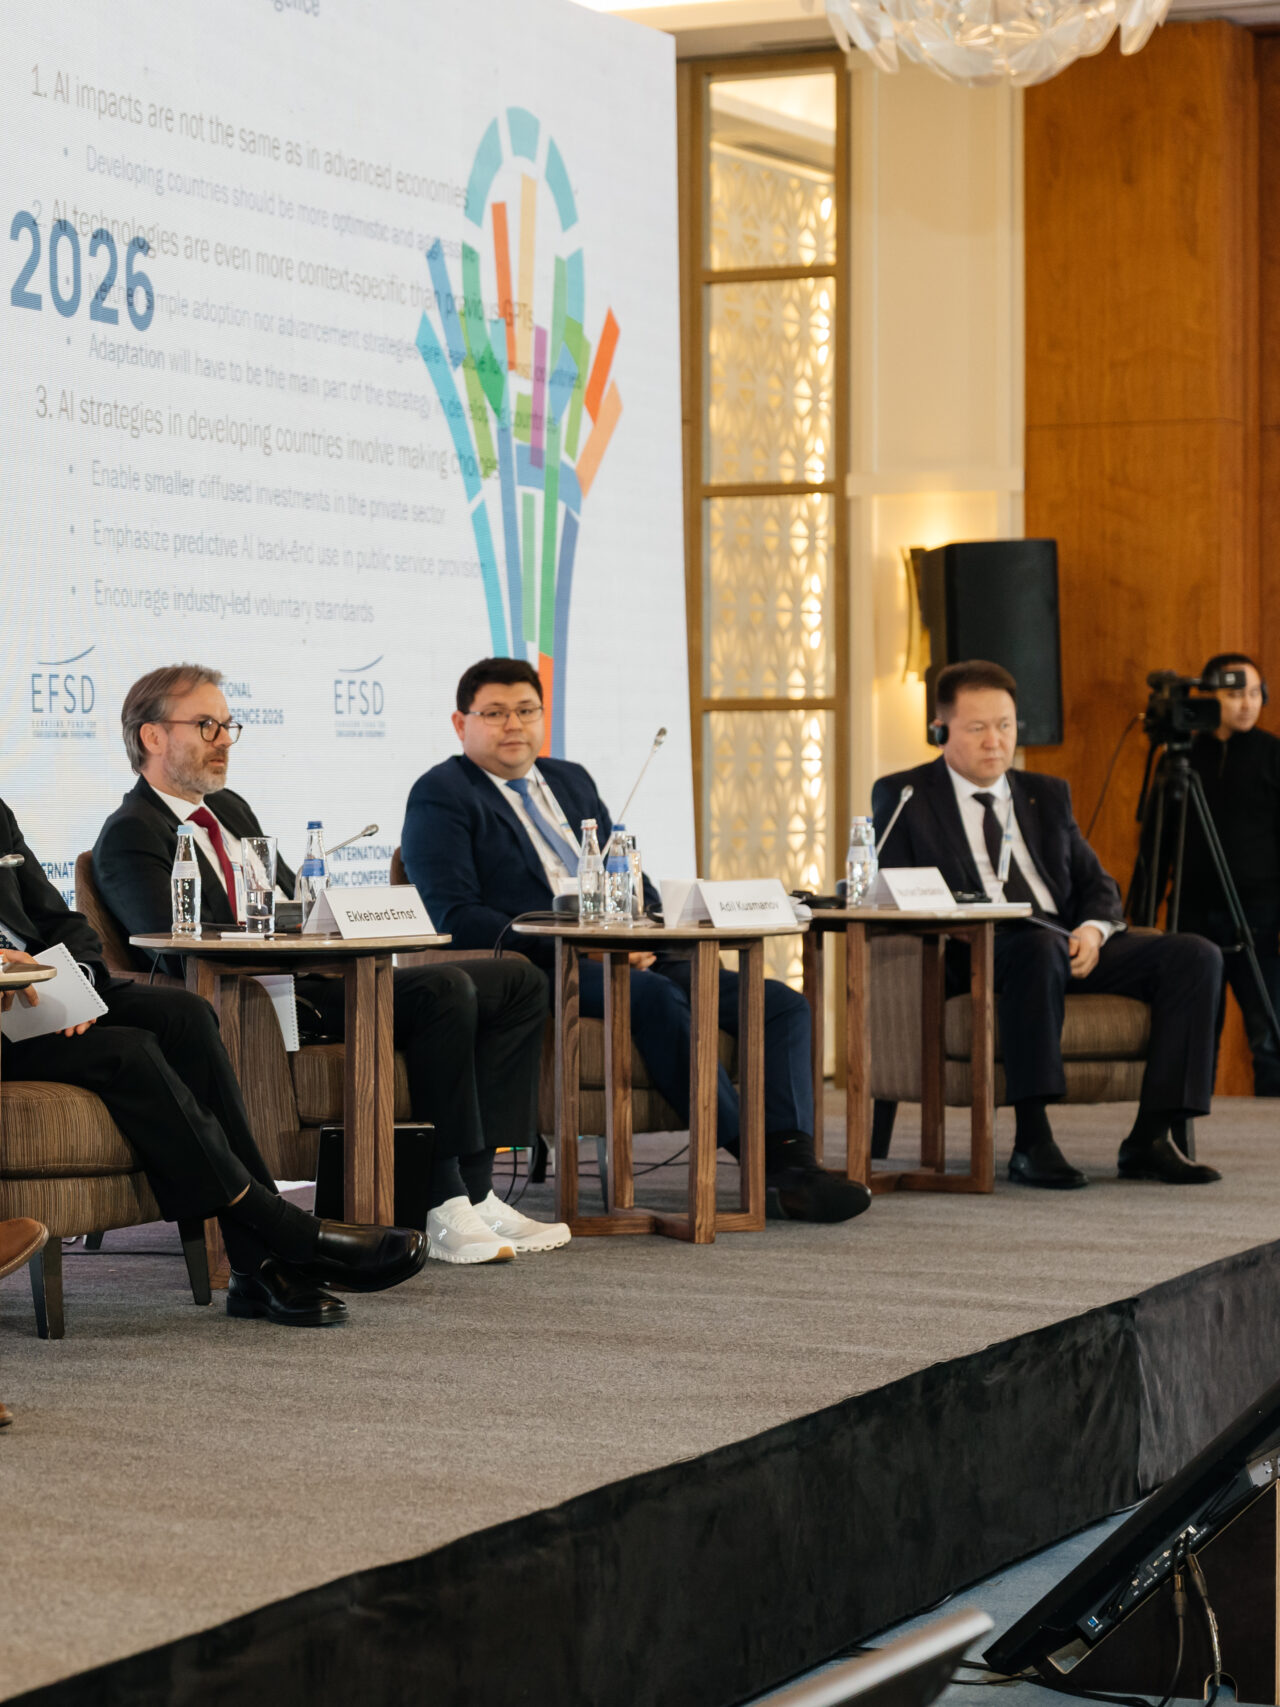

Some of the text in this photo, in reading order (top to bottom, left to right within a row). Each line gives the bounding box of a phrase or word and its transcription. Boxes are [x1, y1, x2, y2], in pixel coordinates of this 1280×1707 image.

[32, 64, 469, 209] 1. AI impacts are not the same as in advanced economies
[86, 144, 164, 196] Developing
[168, 172, 230, 206] countries
[233, 183, 277, 217] should
[279, 192, 294, 220] be
[297, 202, 329, 229] more
[9, 210, 155, 331] 2026
[184, 234, 210, 264] are
[215, 241, 251, 273] even
[256, 252, 294, 282] more
[89, 333, 165, 369] Adaptation
[170, 348, 190, 374] will
[195, 351, 226, 381] have
[229, 360, 242, 383] to
[246, 361, 262, 386] be
[265, 369, 286, 391] the
[36, 384, 53, 420] 3.
[58, 389, 74, 423] AI
[80, 395, 163, 439] strategies
[168, 405, 182, 436] in
[187, 409, 272, 456] developing
[276, 427, 344, 461] countries
[347, 433, 395, 467] involve
[398, 440, 447, 479] making
[92, 459, 139, 492] Enable
[144, 464, 195, 498] smaller
[199, 470, 252, 504] diffused
[255, 483, 330, 513] investments
[347, 490, 366, 516] the
[93, 519, 169, 556] Emphasize
[173, 525, 238, 559] predictive
[257, 536, 314, 564] back-end
[94, 579, 374, 622] Encourage industry-led voluntary standards
[31, 673, 95, 714] EFSD
[334, 680, 384, 715] EFSD
[262, 709, 284, 725] 2026
[333, 845, 394, 861] INTERNATIONA
[346, 906, 417, 923] Ekkehard Ernst
